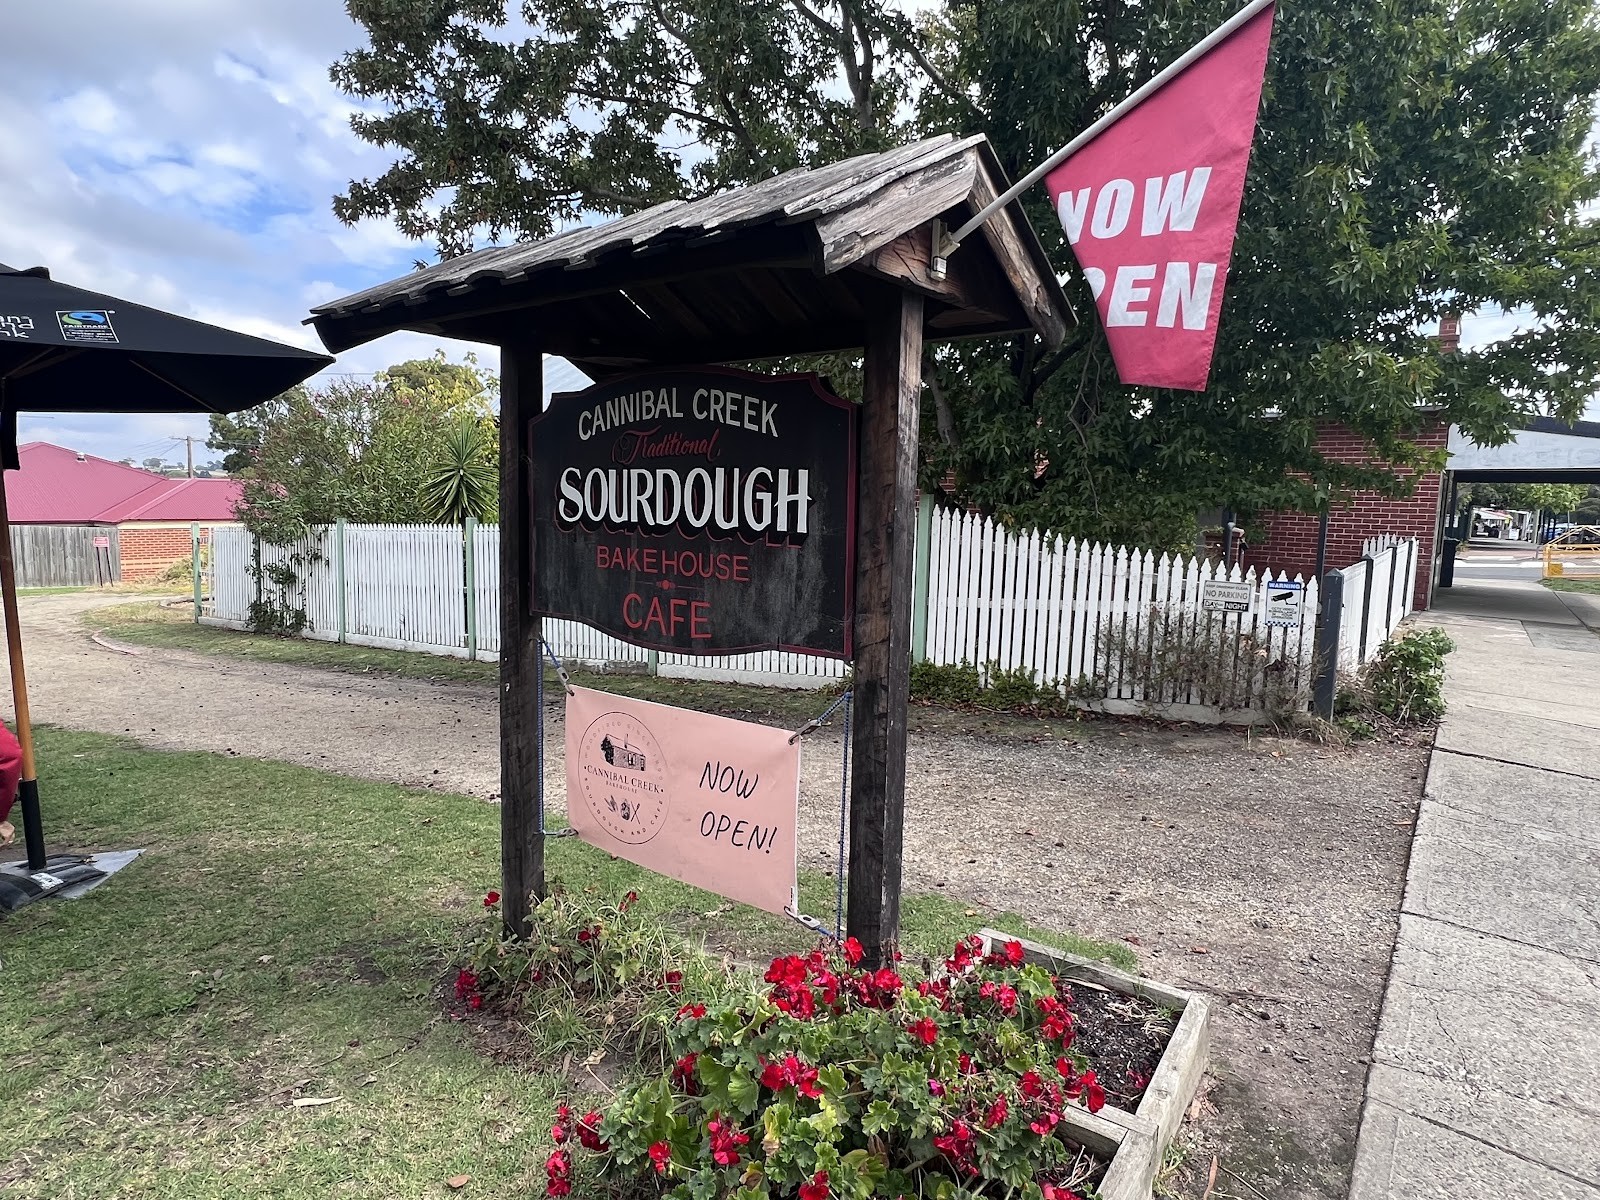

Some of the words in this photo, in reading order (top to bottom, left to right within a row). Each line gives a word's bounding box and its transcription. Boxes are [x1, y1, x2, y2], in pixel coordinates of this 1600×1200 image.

[1057, 166, 1213, 246] NOW
[578, 387, 684, 441] CANNIBAL
[692, 388, 779, 438] CREEK
[558, 466, 813, 534] SOURDOUGH
[596, 545, 750, 582] BAKEHOUSE
[1218, 590, 1248, 600] PARKING
[1225, 602, 1248, 610] NIGHT
[622, 592, 712, 639] CAFE
[587, 764, 630, 785] CANNIBAL
[631, 777, 660, 794] CREEK
[699, 761, 759, 799] NOW
[700, 811, 778, 854] OPEN!
